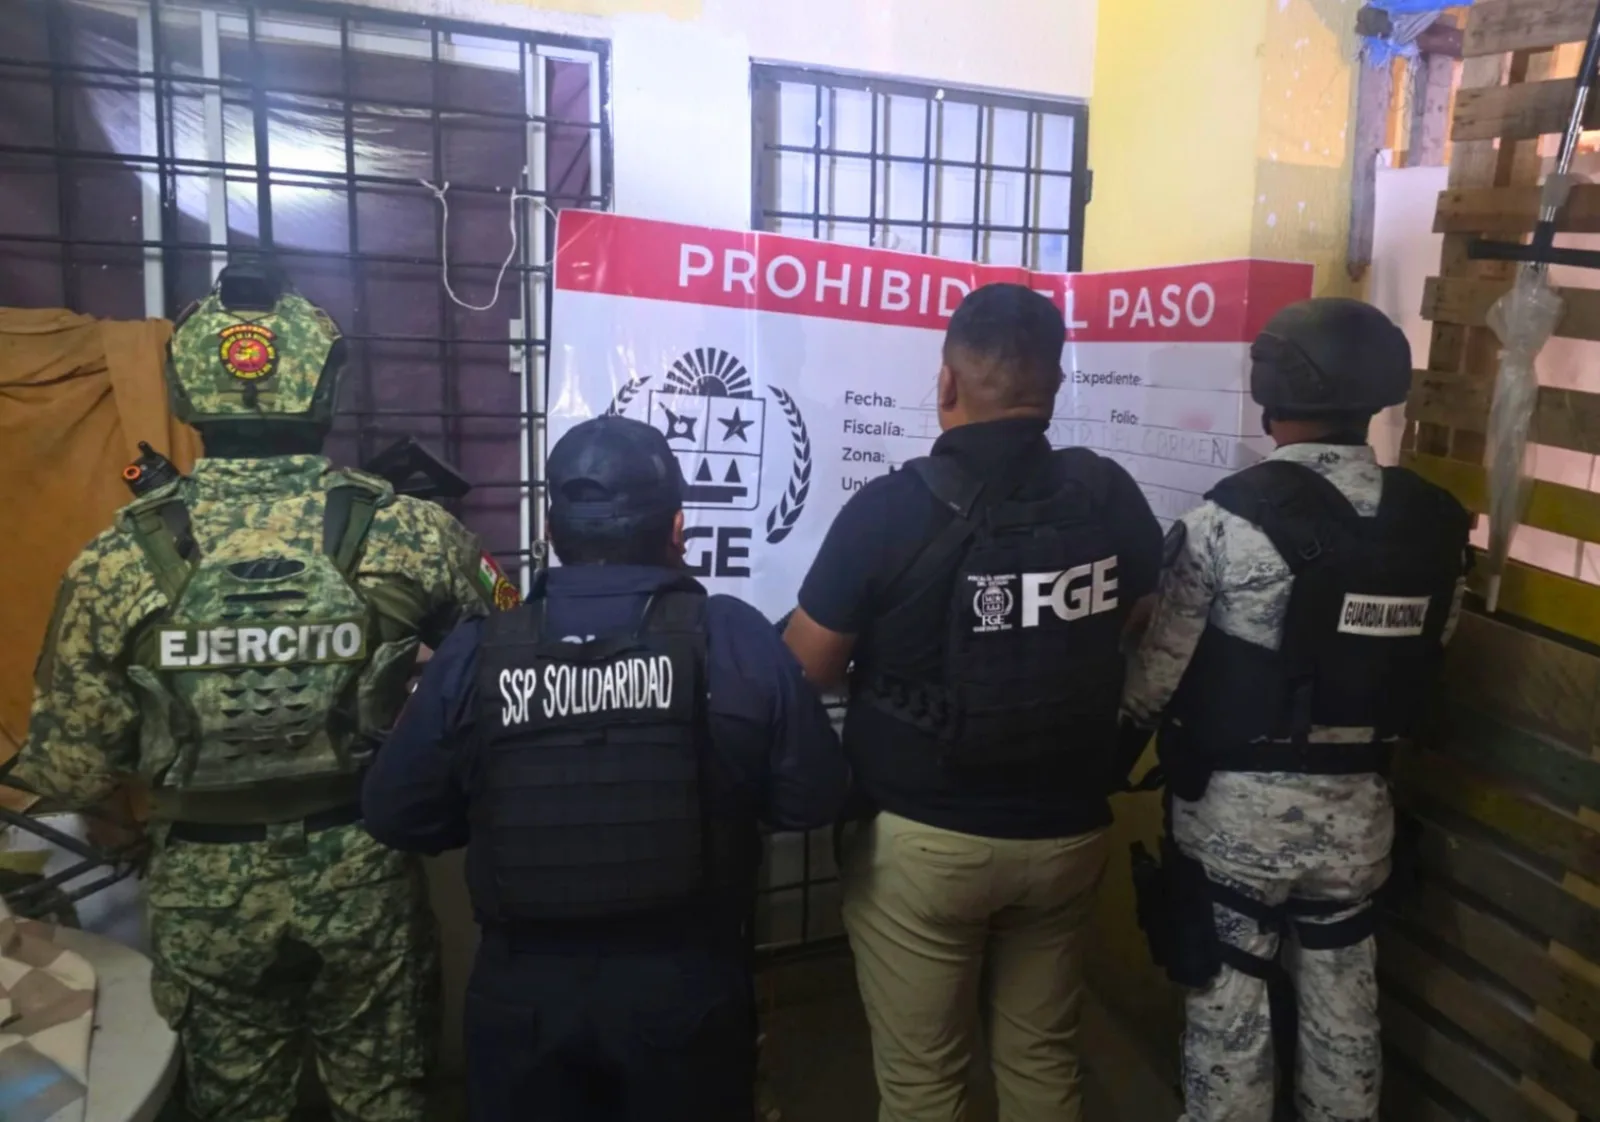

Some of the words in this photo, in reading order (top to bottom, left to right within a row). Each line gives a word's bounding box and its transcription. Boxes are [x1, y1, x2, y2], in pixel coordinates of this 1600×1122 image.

[678, 243, 970, 319] PROHIBID
[1108, 282, 1216, 328] PASO
[844, 390, 896, 408] Fecha:
[843, 419, 905, 437] Fiscalía:
[1110, 409, 1139, 425] Folio:
[842, 446, 885, 464] Zona:
[682, 526, 752, 578] GE
[1021, 555, 1118, 628] FGE
[982, 614, 1005, 626] FGE
[1344, 601, 1384, 627] GUARDIA
[499, 668, 537, 726] SSP
[543, 656, 673, 718] SOLIDARIDAD
